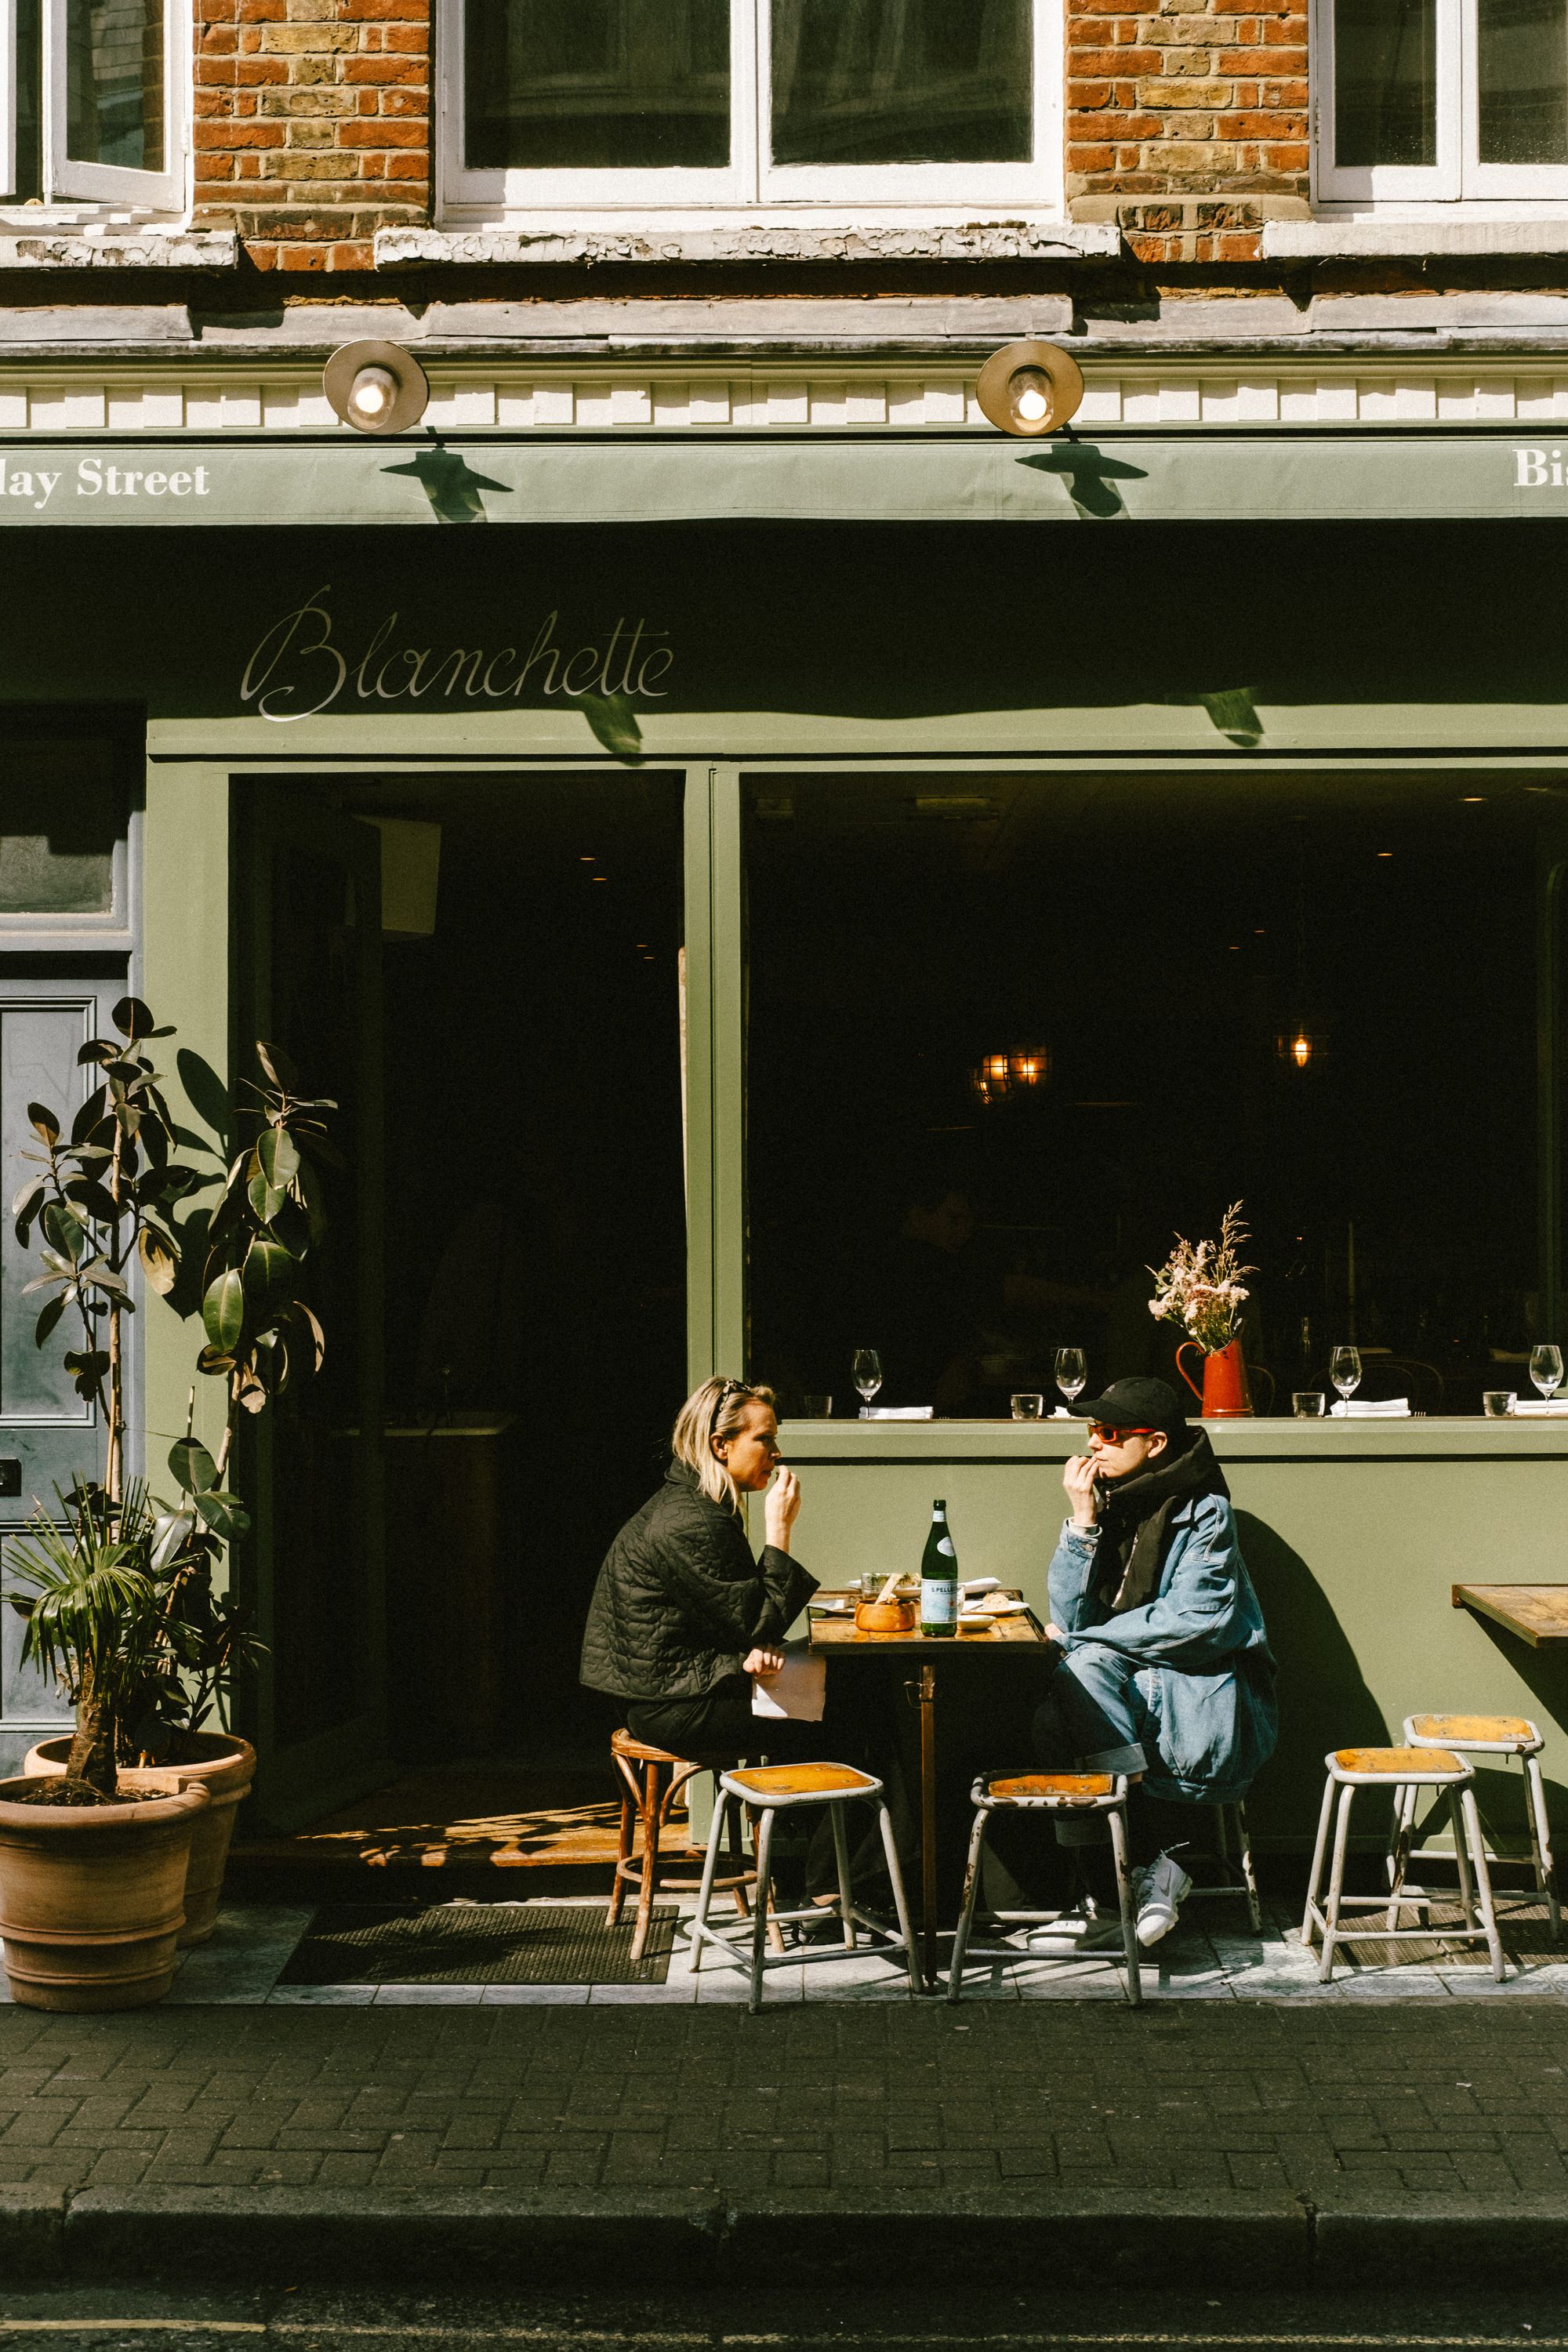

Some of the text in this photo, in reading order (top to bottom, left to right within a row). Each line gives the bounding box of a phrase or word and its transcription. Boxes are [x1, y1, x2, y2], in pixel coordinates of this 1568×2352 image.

[77, 459, 210, 495] Street
[1512, 448, 1568, 486] Bi
[240, 584, 673, 722] Blanchette
